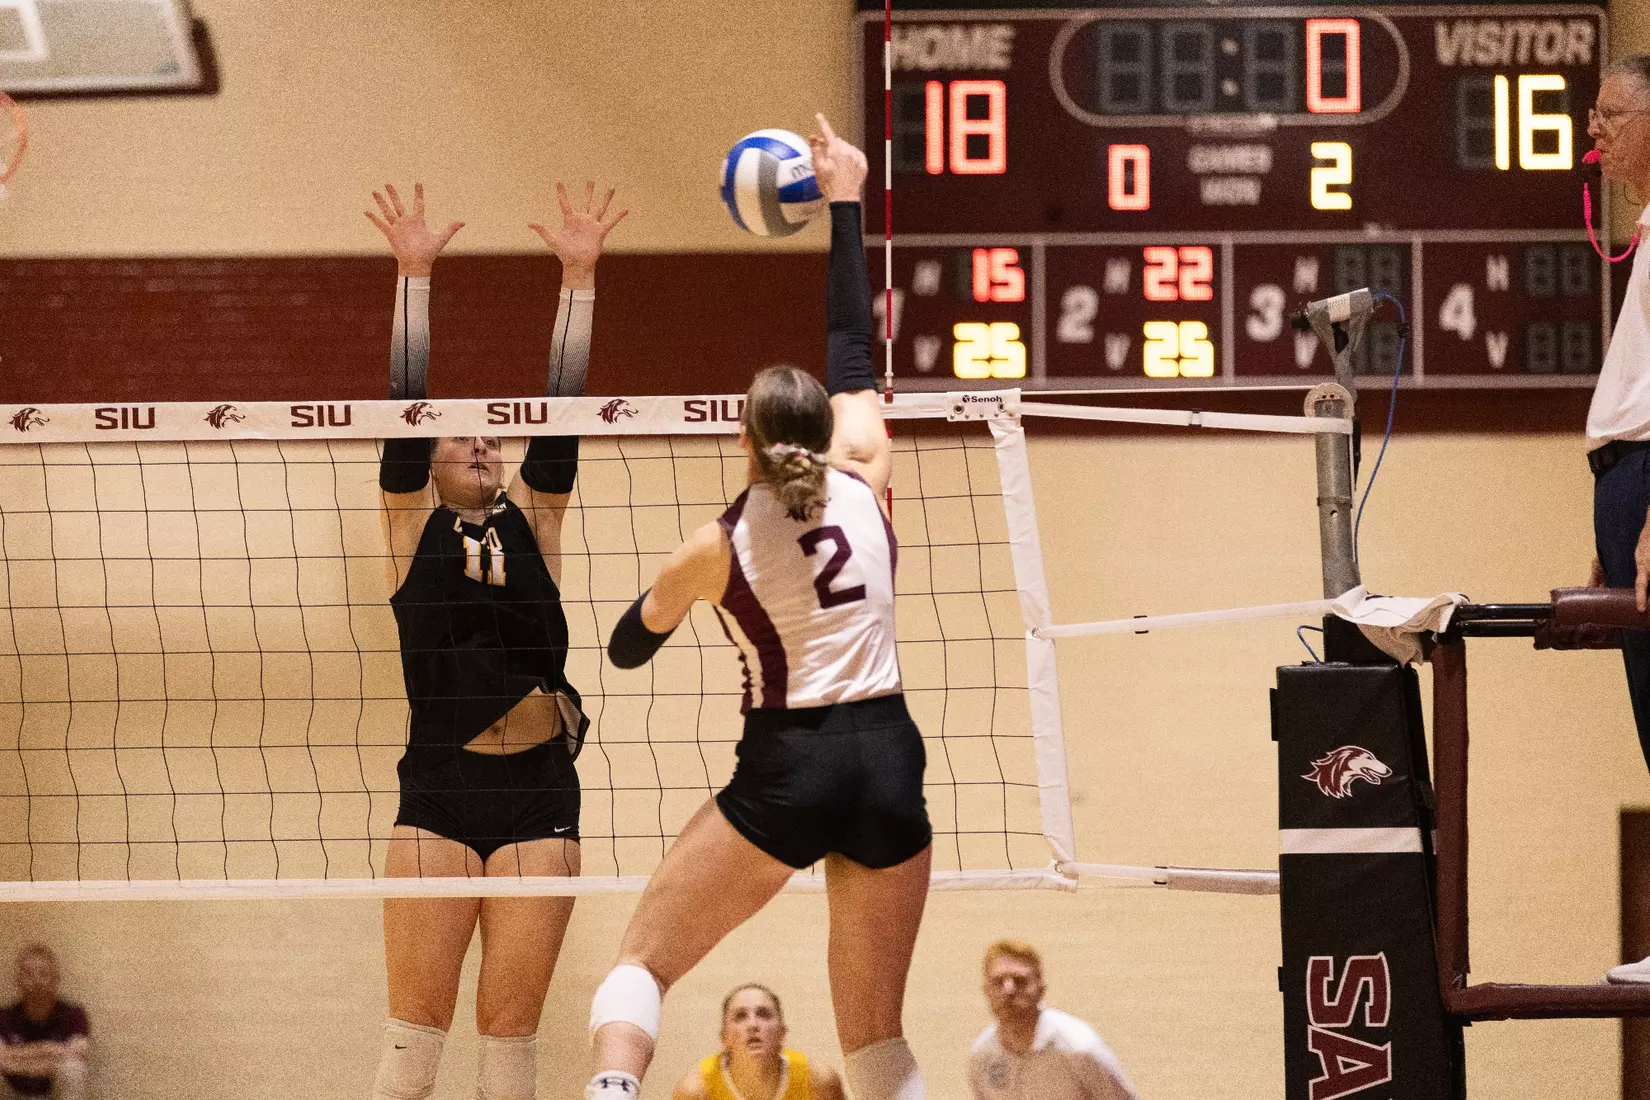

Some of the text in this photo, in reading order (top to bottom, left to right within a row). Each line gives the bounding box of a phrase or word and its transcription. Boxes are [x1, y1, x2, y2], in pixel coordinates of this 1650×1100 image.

[885, 25, 1015, 69] HOME
[1305, 18, 1361, 113] 0
[1434, 20, 1595, 65] VISITOR
[925, 80, 1007, 175] 18
[1494, 74, 1574, 171] 16
[1108, 143, 1151, 211] 0
[1310, 141, 1353, 210] 2
[972, 248, 1026, 302] 15
[1143, 246, 1214, 301] 22
[1056, 284, 1100, 344] 2
[1246, 283, 1286, 342] 3
[1439, 282, 1477, 341] 4
[953, 322, 1026, 379] 25
[1143, 321, 1214, 377] 25
[94, 400, 744, 430] SIU SIU SIU SIU
[971, 395, 1002, 403] Senoh
[797, 525, 866, 609] 2
